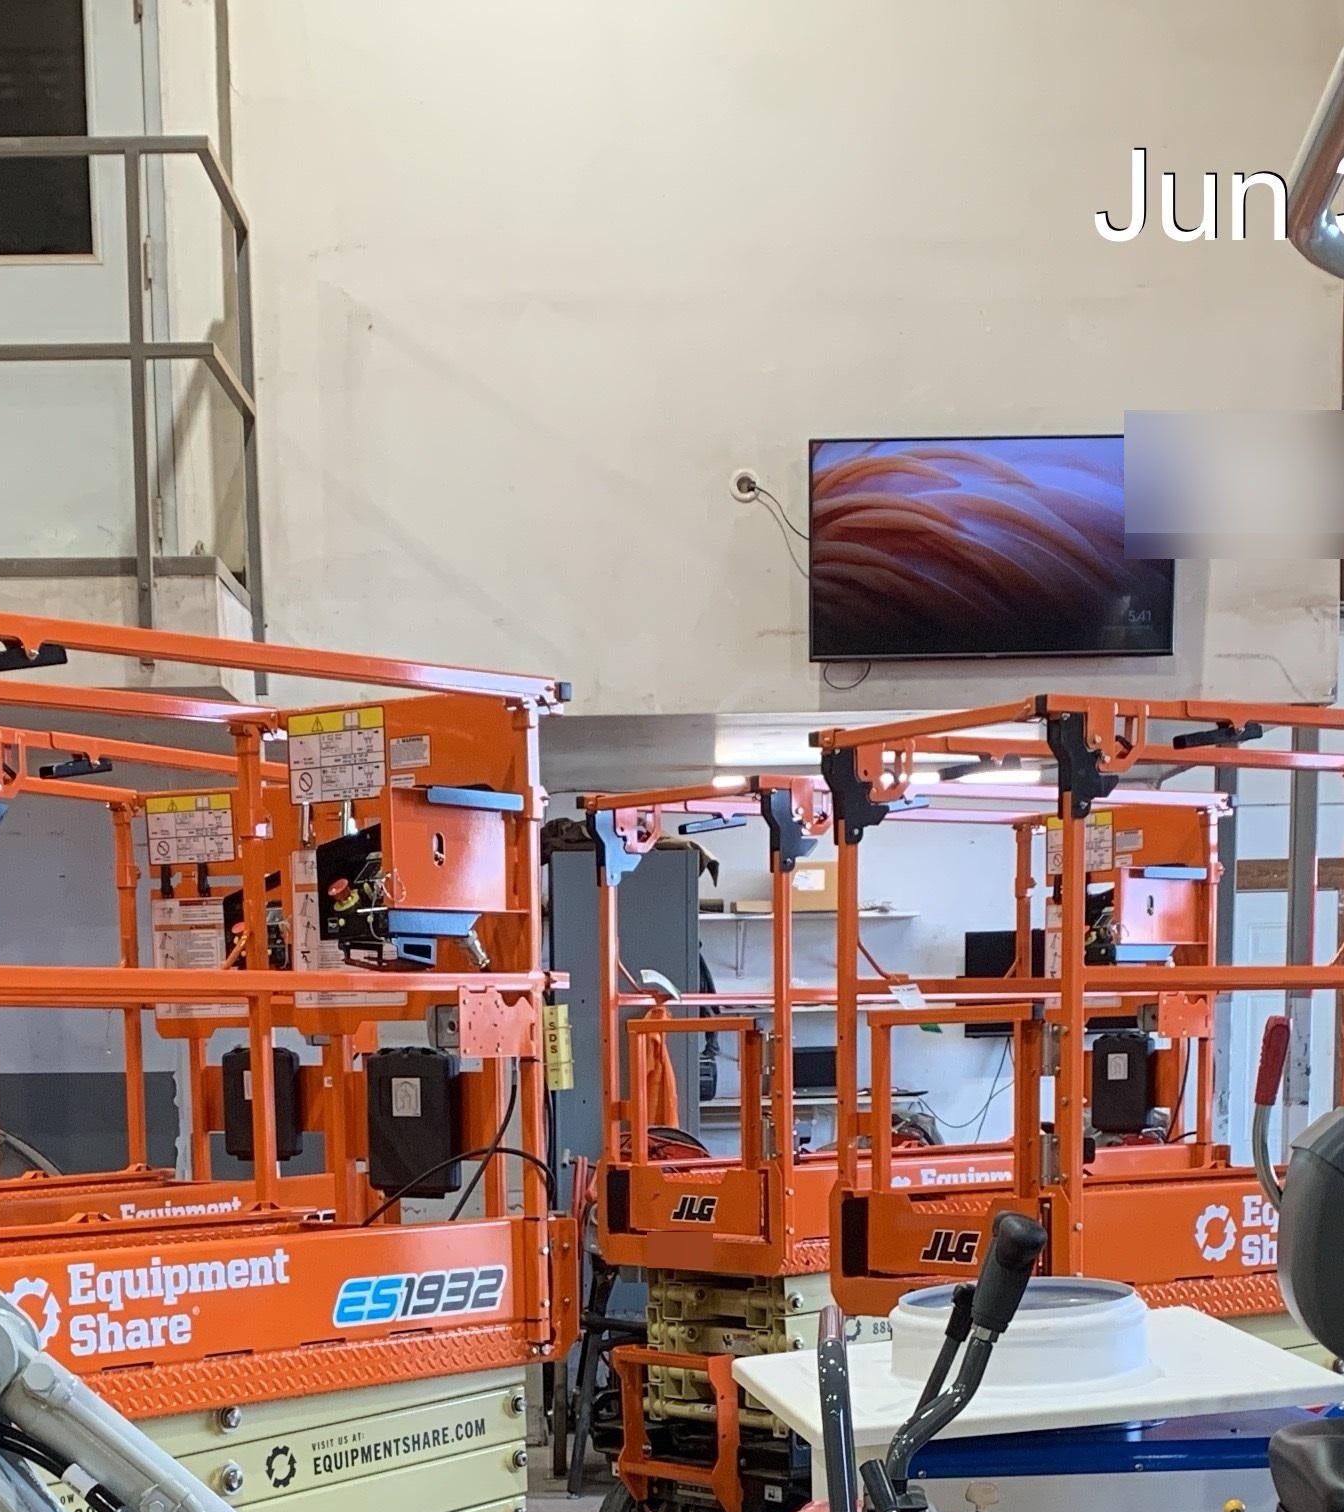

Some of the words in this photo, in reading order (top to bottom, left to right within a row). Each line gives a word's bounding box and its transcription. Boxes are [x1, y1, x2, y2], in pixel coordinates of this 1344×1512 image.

[671, 1195, 718, 1223] JLG
[920, 1230, 981, 1264] JLG
[67, 1248, 290, 1311] Equipment
[335, 1266, 506, 1326] ES1932
[69, 1311, 193, 1357] Share
[311, 1438, 334, 1451] VISIT
[338, 1435, 348, 1445] US
[313, 1418, 486, 1475] EQUIPMENTSHARE.COM
